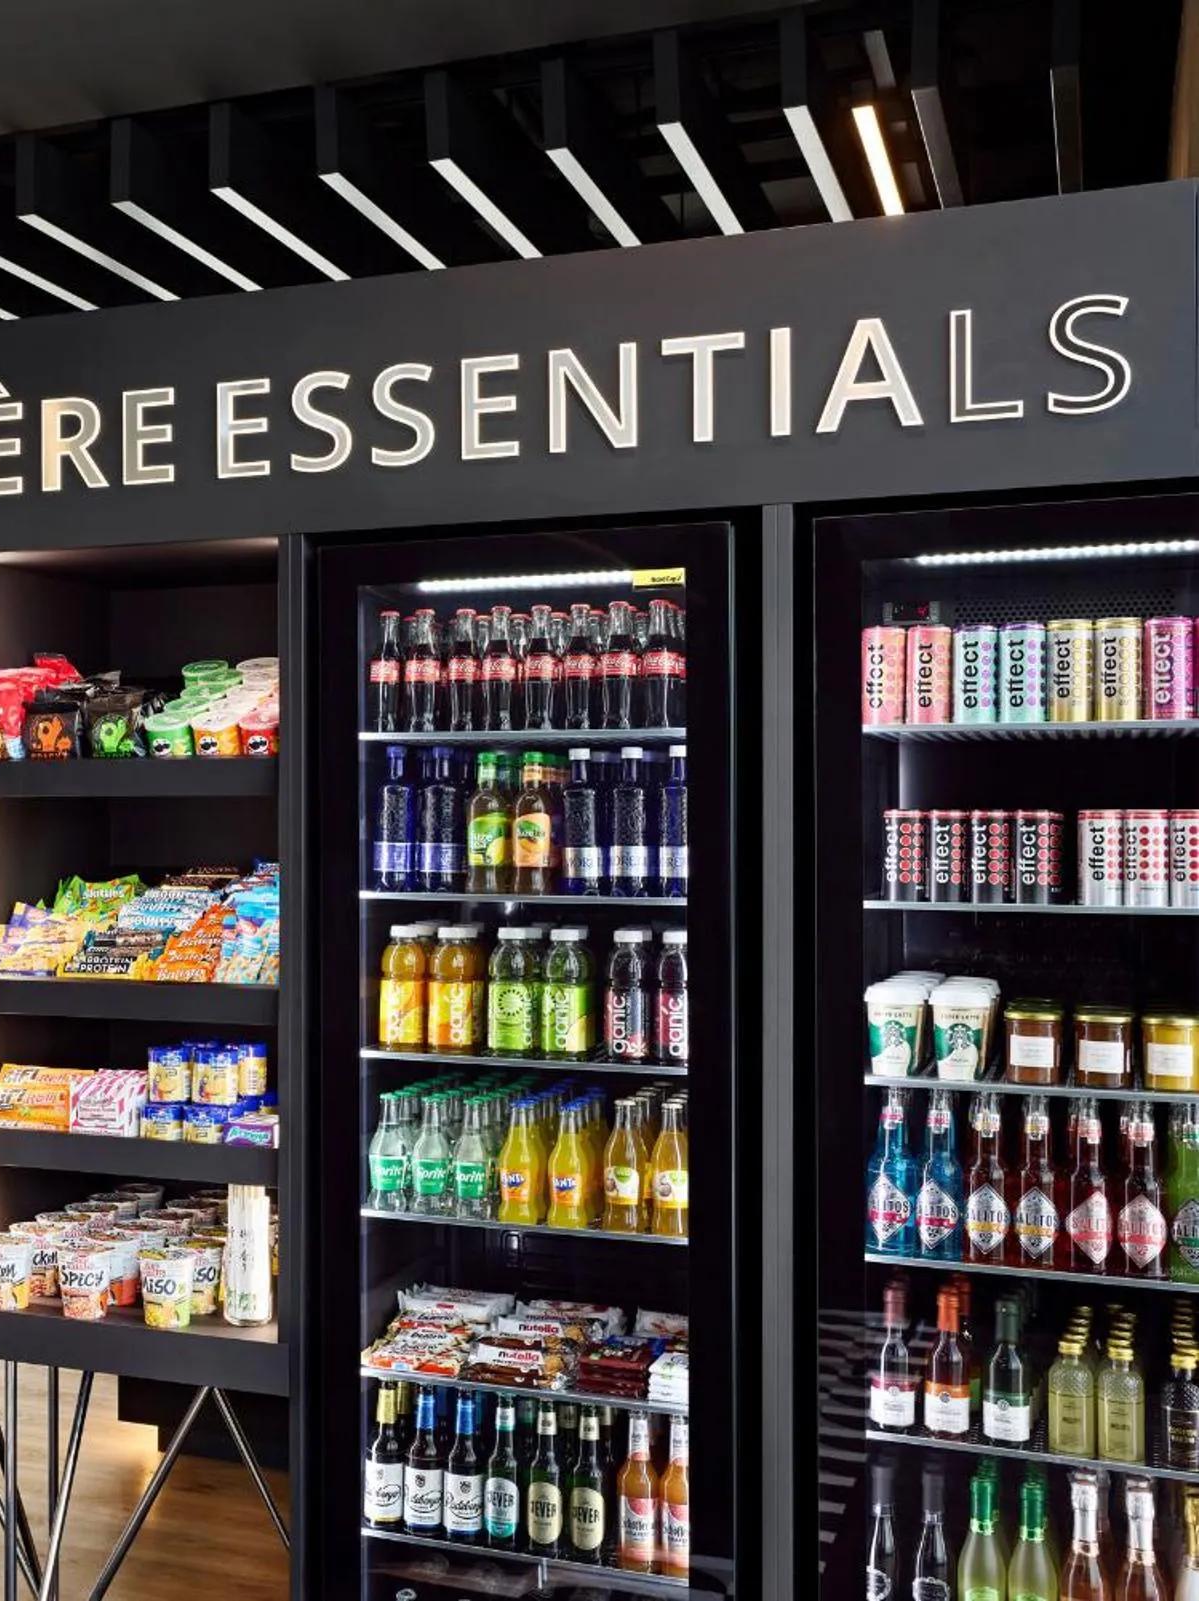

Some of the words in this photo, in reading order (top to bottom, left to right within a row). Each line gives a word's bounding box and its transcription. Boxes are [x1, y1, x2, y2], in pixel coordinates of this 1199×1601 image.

[214, 293, 1133, 480] ESSENTIALS
[917, 642, 933, 709] effect
[963, 641, 979, 709] effect
[1008, 639, 1025, 709] effect
[1056, 637, 1071, 699] effect
[1103, 636, 1118, 699] effect
[935, 824, 950, 884] effect
[973, 824, 987, 884] effect
[1021, 824, 1036, 885] effect
[1091, 825, 1105, 882] effect
[498, 1350, 540, 1363] nutella
[518, 1322, 560, 1335] nutella
